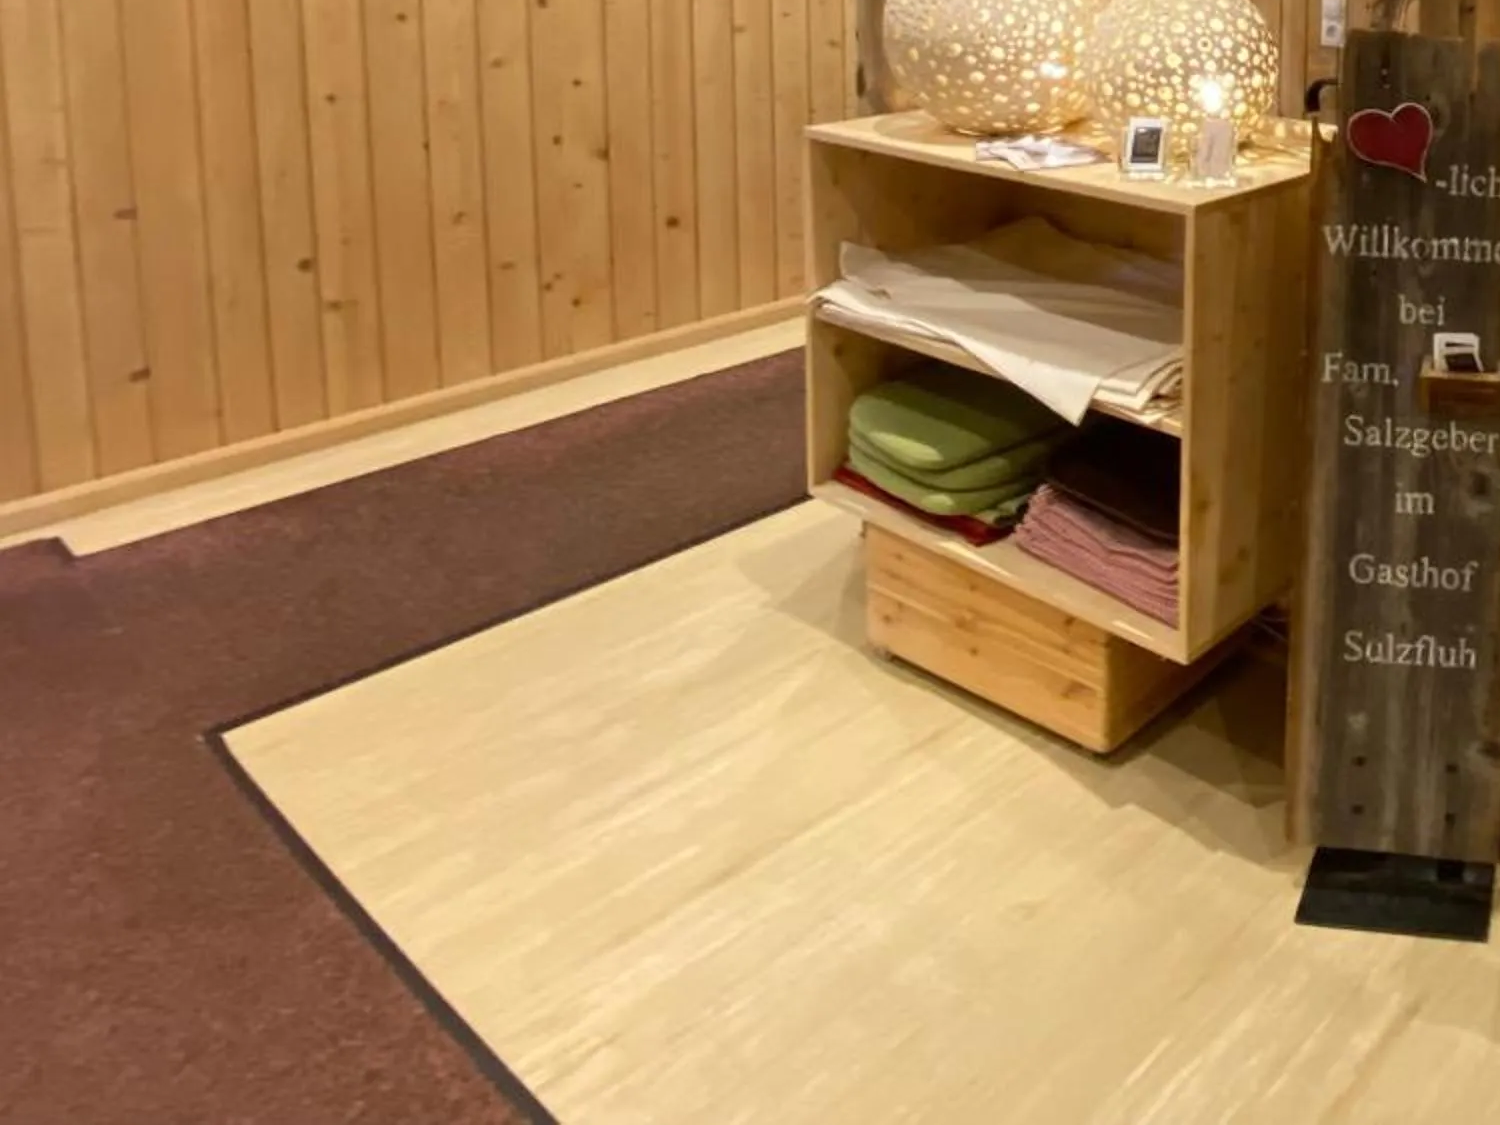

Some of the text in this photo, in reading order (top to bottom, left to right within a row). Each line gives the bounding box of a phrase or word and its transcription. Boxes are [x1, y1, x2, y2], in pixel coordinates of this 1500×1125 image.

[1398, 293, 1446, 327] bei
[1320, 352, 1400, 388] Fam.
[1343, 414, 1500, 458] Salzgeber
[1394, 481, 1436, 516] im
[1349, 552, 1479, 592] Gasthof
[1343, 629, 1478, 670] Sulzfluh
